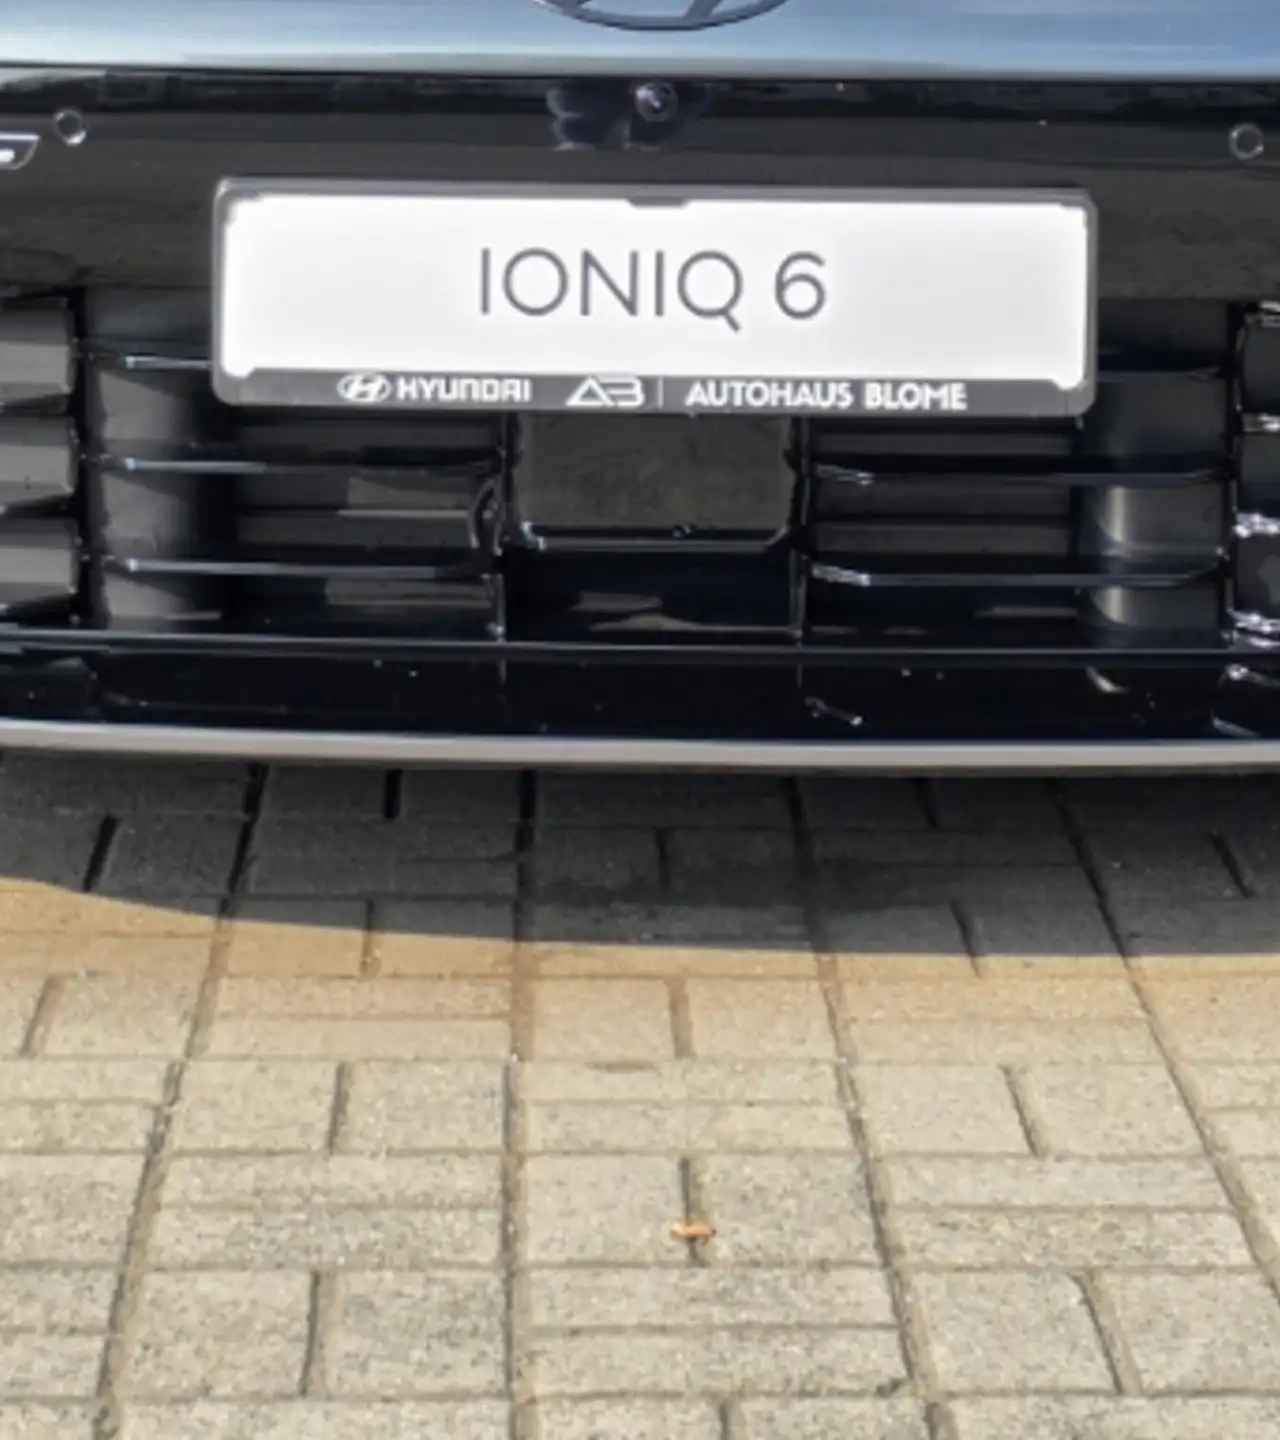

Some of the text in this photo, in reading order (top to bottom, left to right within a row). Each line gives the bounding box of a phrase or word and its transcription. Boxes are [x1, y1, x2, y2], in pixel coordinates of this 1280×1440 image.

[480, 247, 827, 333] IONIQ 6
[396, 377, 531, 403] HYUNDAI
[685, 380, 853, 407] AUTOHAUS
[865, 382, 968, 410] BLOME
